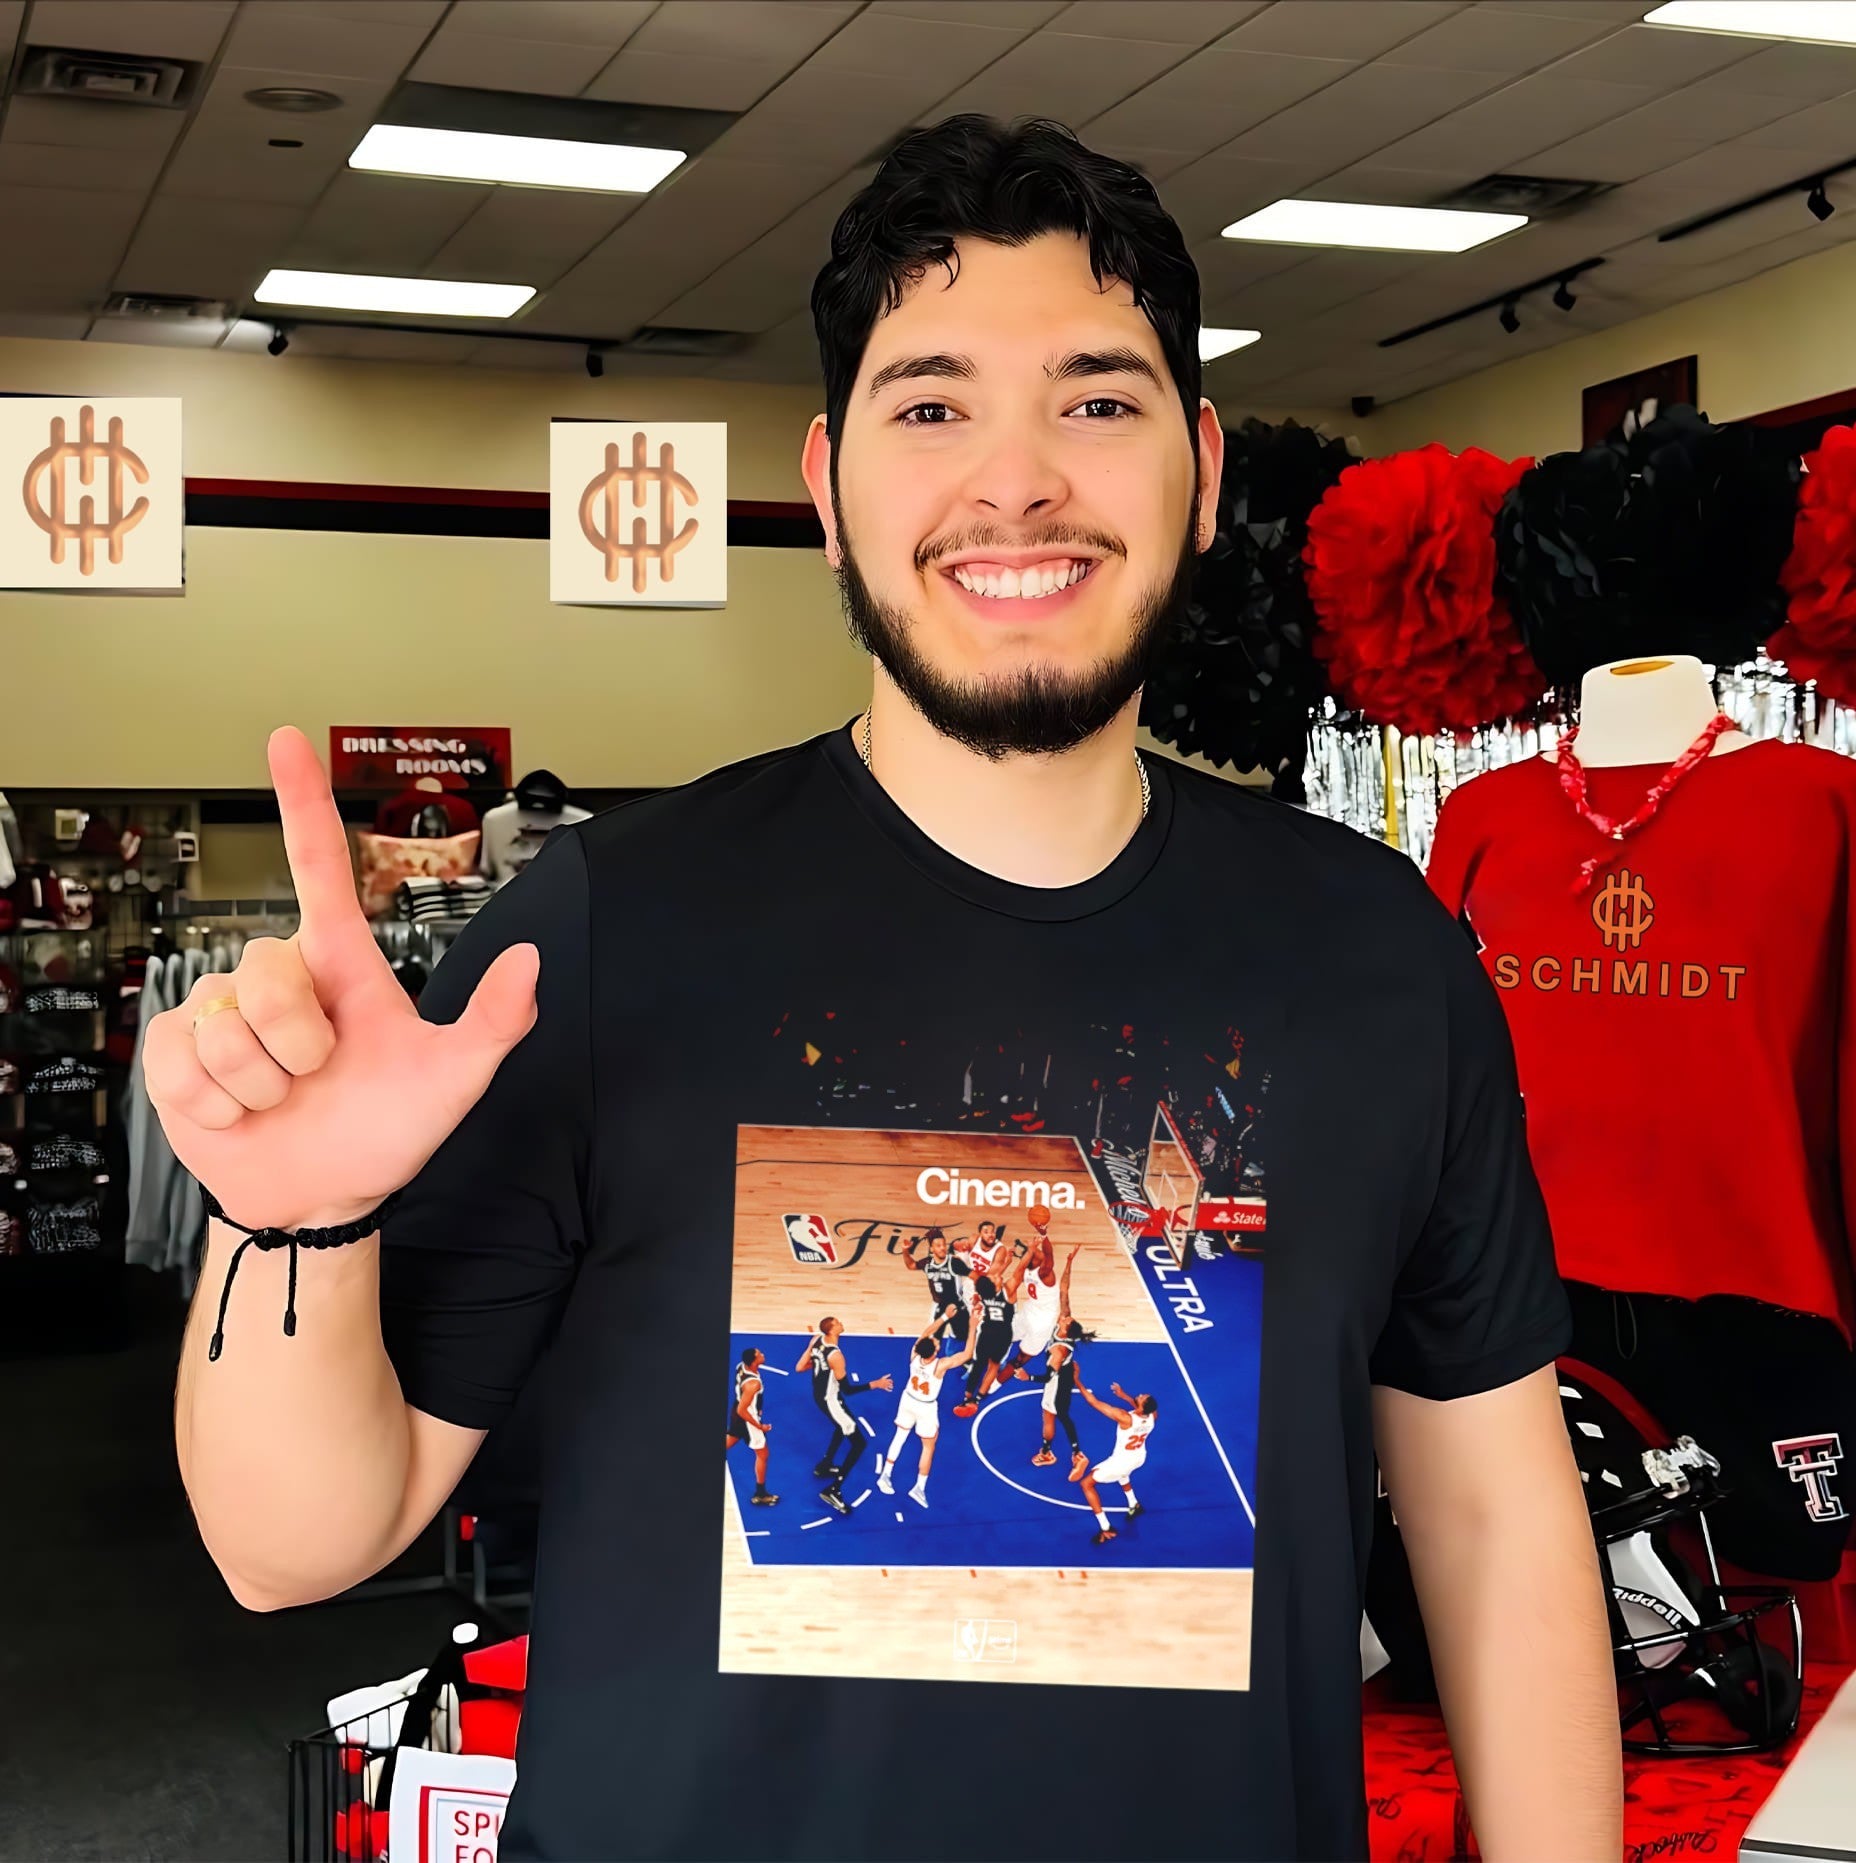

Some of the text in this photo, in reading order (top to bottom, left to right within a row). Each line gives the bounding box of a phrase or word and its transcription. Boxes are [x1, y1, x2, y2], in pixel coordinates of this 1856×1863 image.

[342, 737, 467, 754] DRESSING
[396, 758, 487, 775] ROOMS
[1494, 953, 1746, 1001] SCHMIDT
[916, 1167, 1086, 1210] Cinema.
[1231, 1211, 1262, 1225] State
[799, 1251, 822, 1262] NBA
[1145, 1245, 1213, 1333] ULTRA
[988, 1306, 1004, 1321] 2
